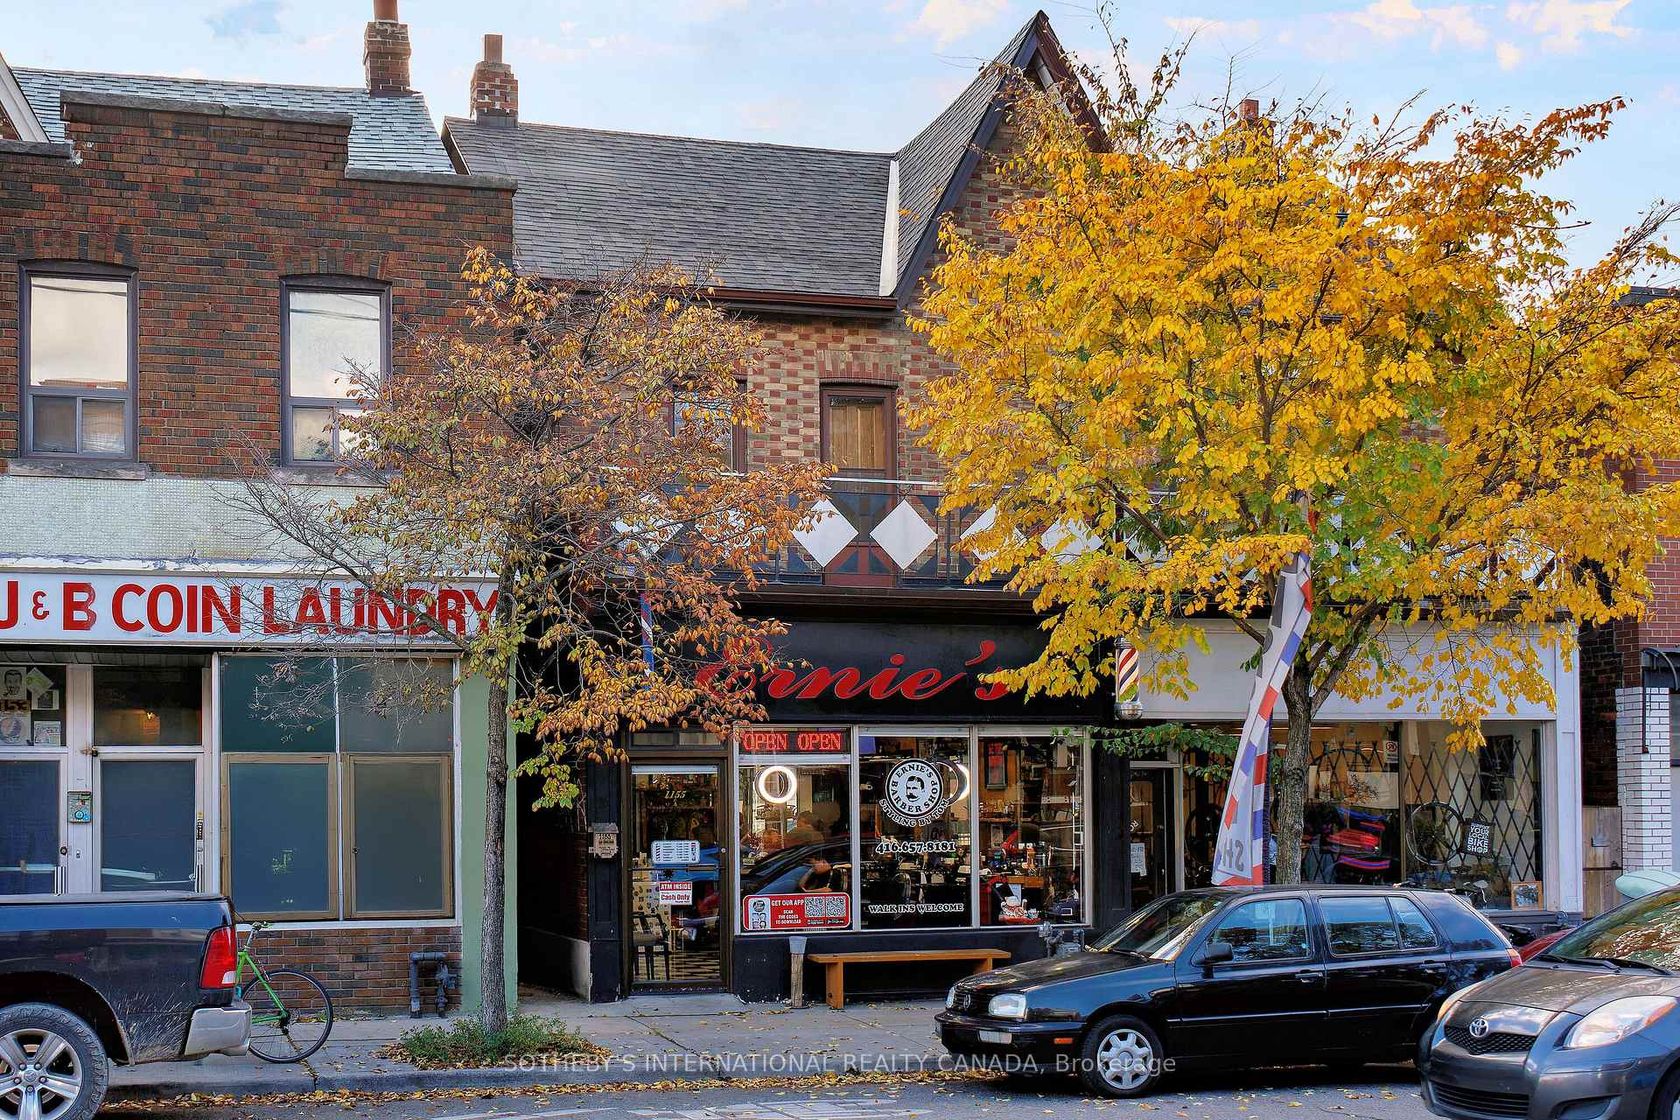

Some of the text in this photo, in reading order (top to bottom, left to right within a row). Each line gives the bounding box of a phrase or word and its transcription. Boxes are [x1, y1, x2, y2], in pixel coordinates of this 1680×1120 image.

[0, 580, 499, 636] J & B COIN LAUNDRY
[743, 732, 840, 750] OPEN OPEN
[895, 763, 933, 778] ERNIE'S
[890, 780, 938, 813] BARBER SHOP
[879, 799, 949, 827] STYLING BY TOM
[1470, 826, 1490, 834] YOUR
[1467, 838, 1489, 848] BIKE
[1467, 845, 1488, 853] SHOP
[868, 903, 964, 914] WALK INS WELCOME
